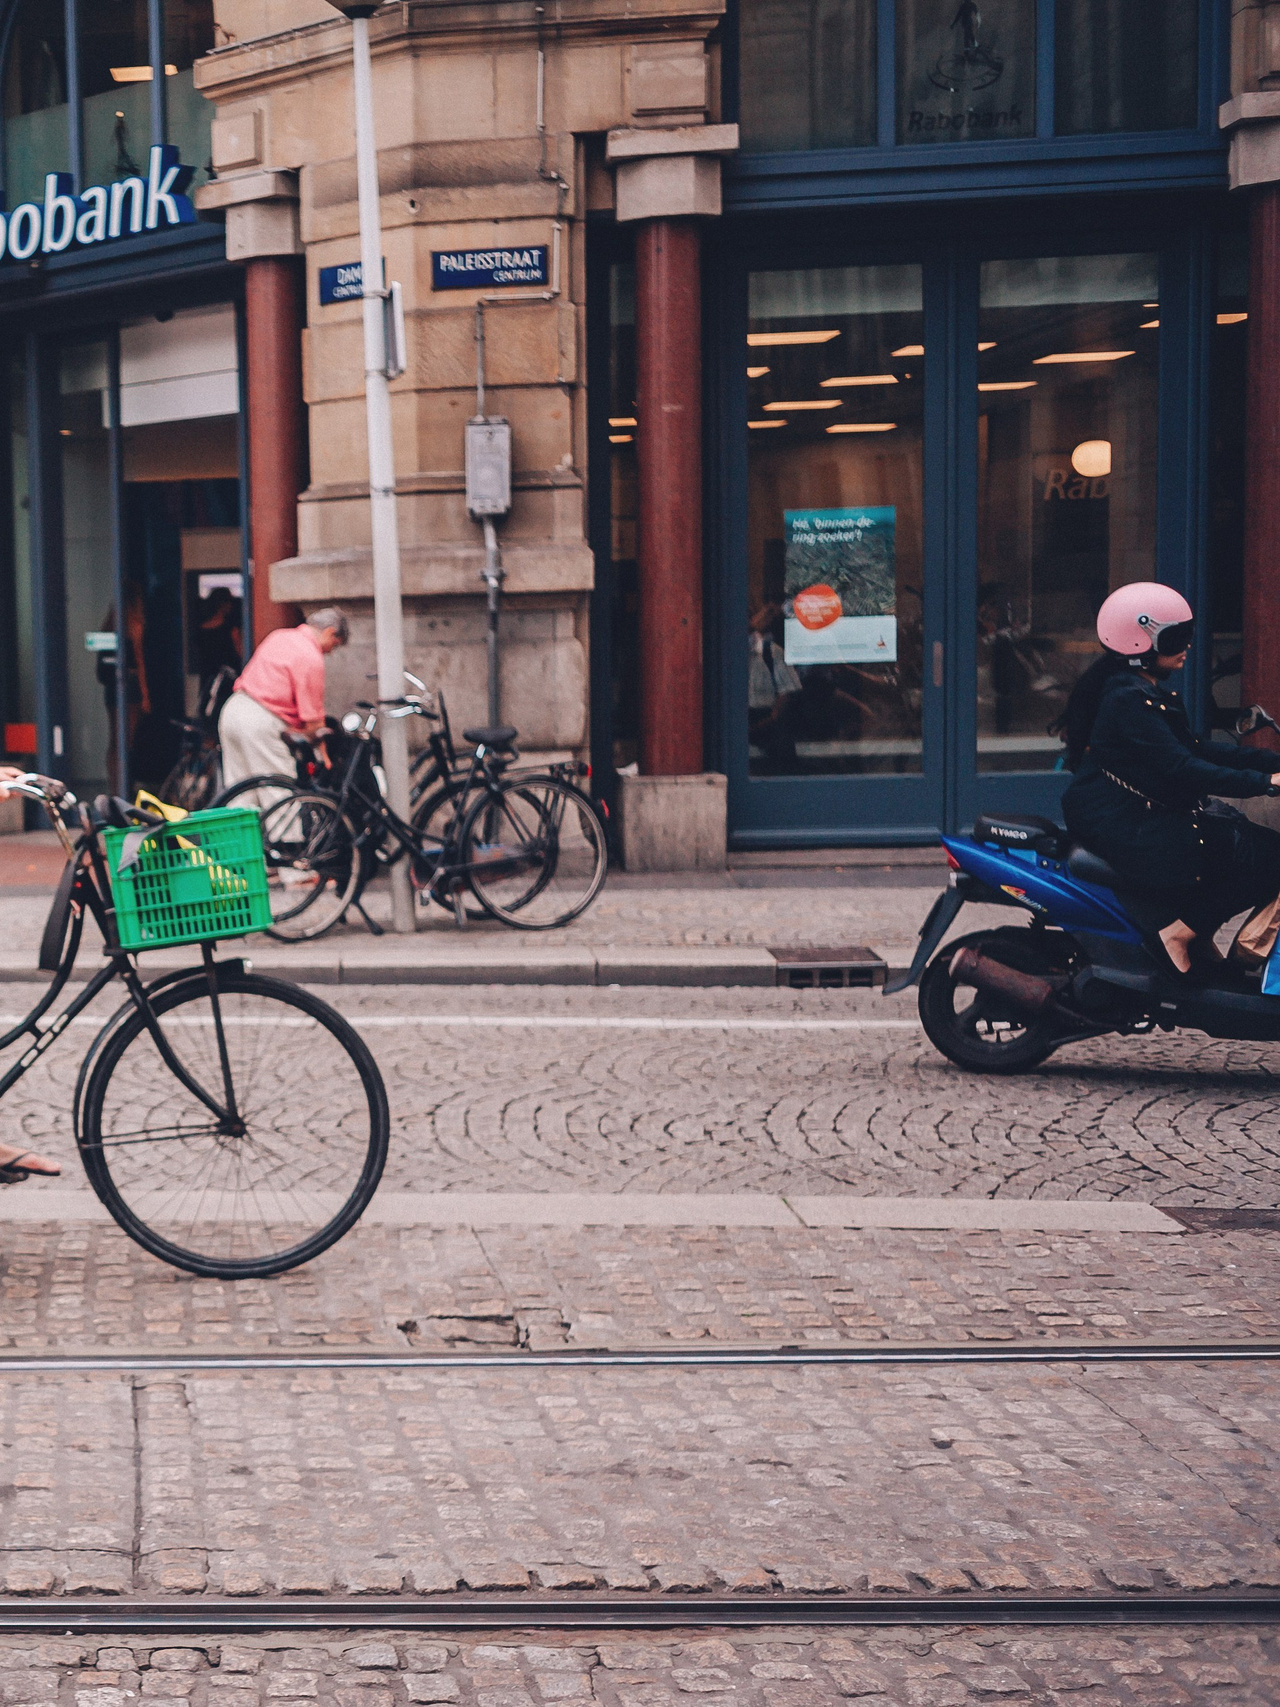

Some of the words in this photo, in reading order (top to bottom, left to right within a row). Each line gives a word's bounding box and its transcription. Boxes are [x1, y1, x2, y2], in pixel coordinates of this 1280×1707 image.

[908, 104, 1022, 132] Rabobank
[440, 249, 542, 272] PALEISSTRAAT
[492, 268, 543, 282] CENTRUM
[990, 826, 1028, 840] KYMCO
